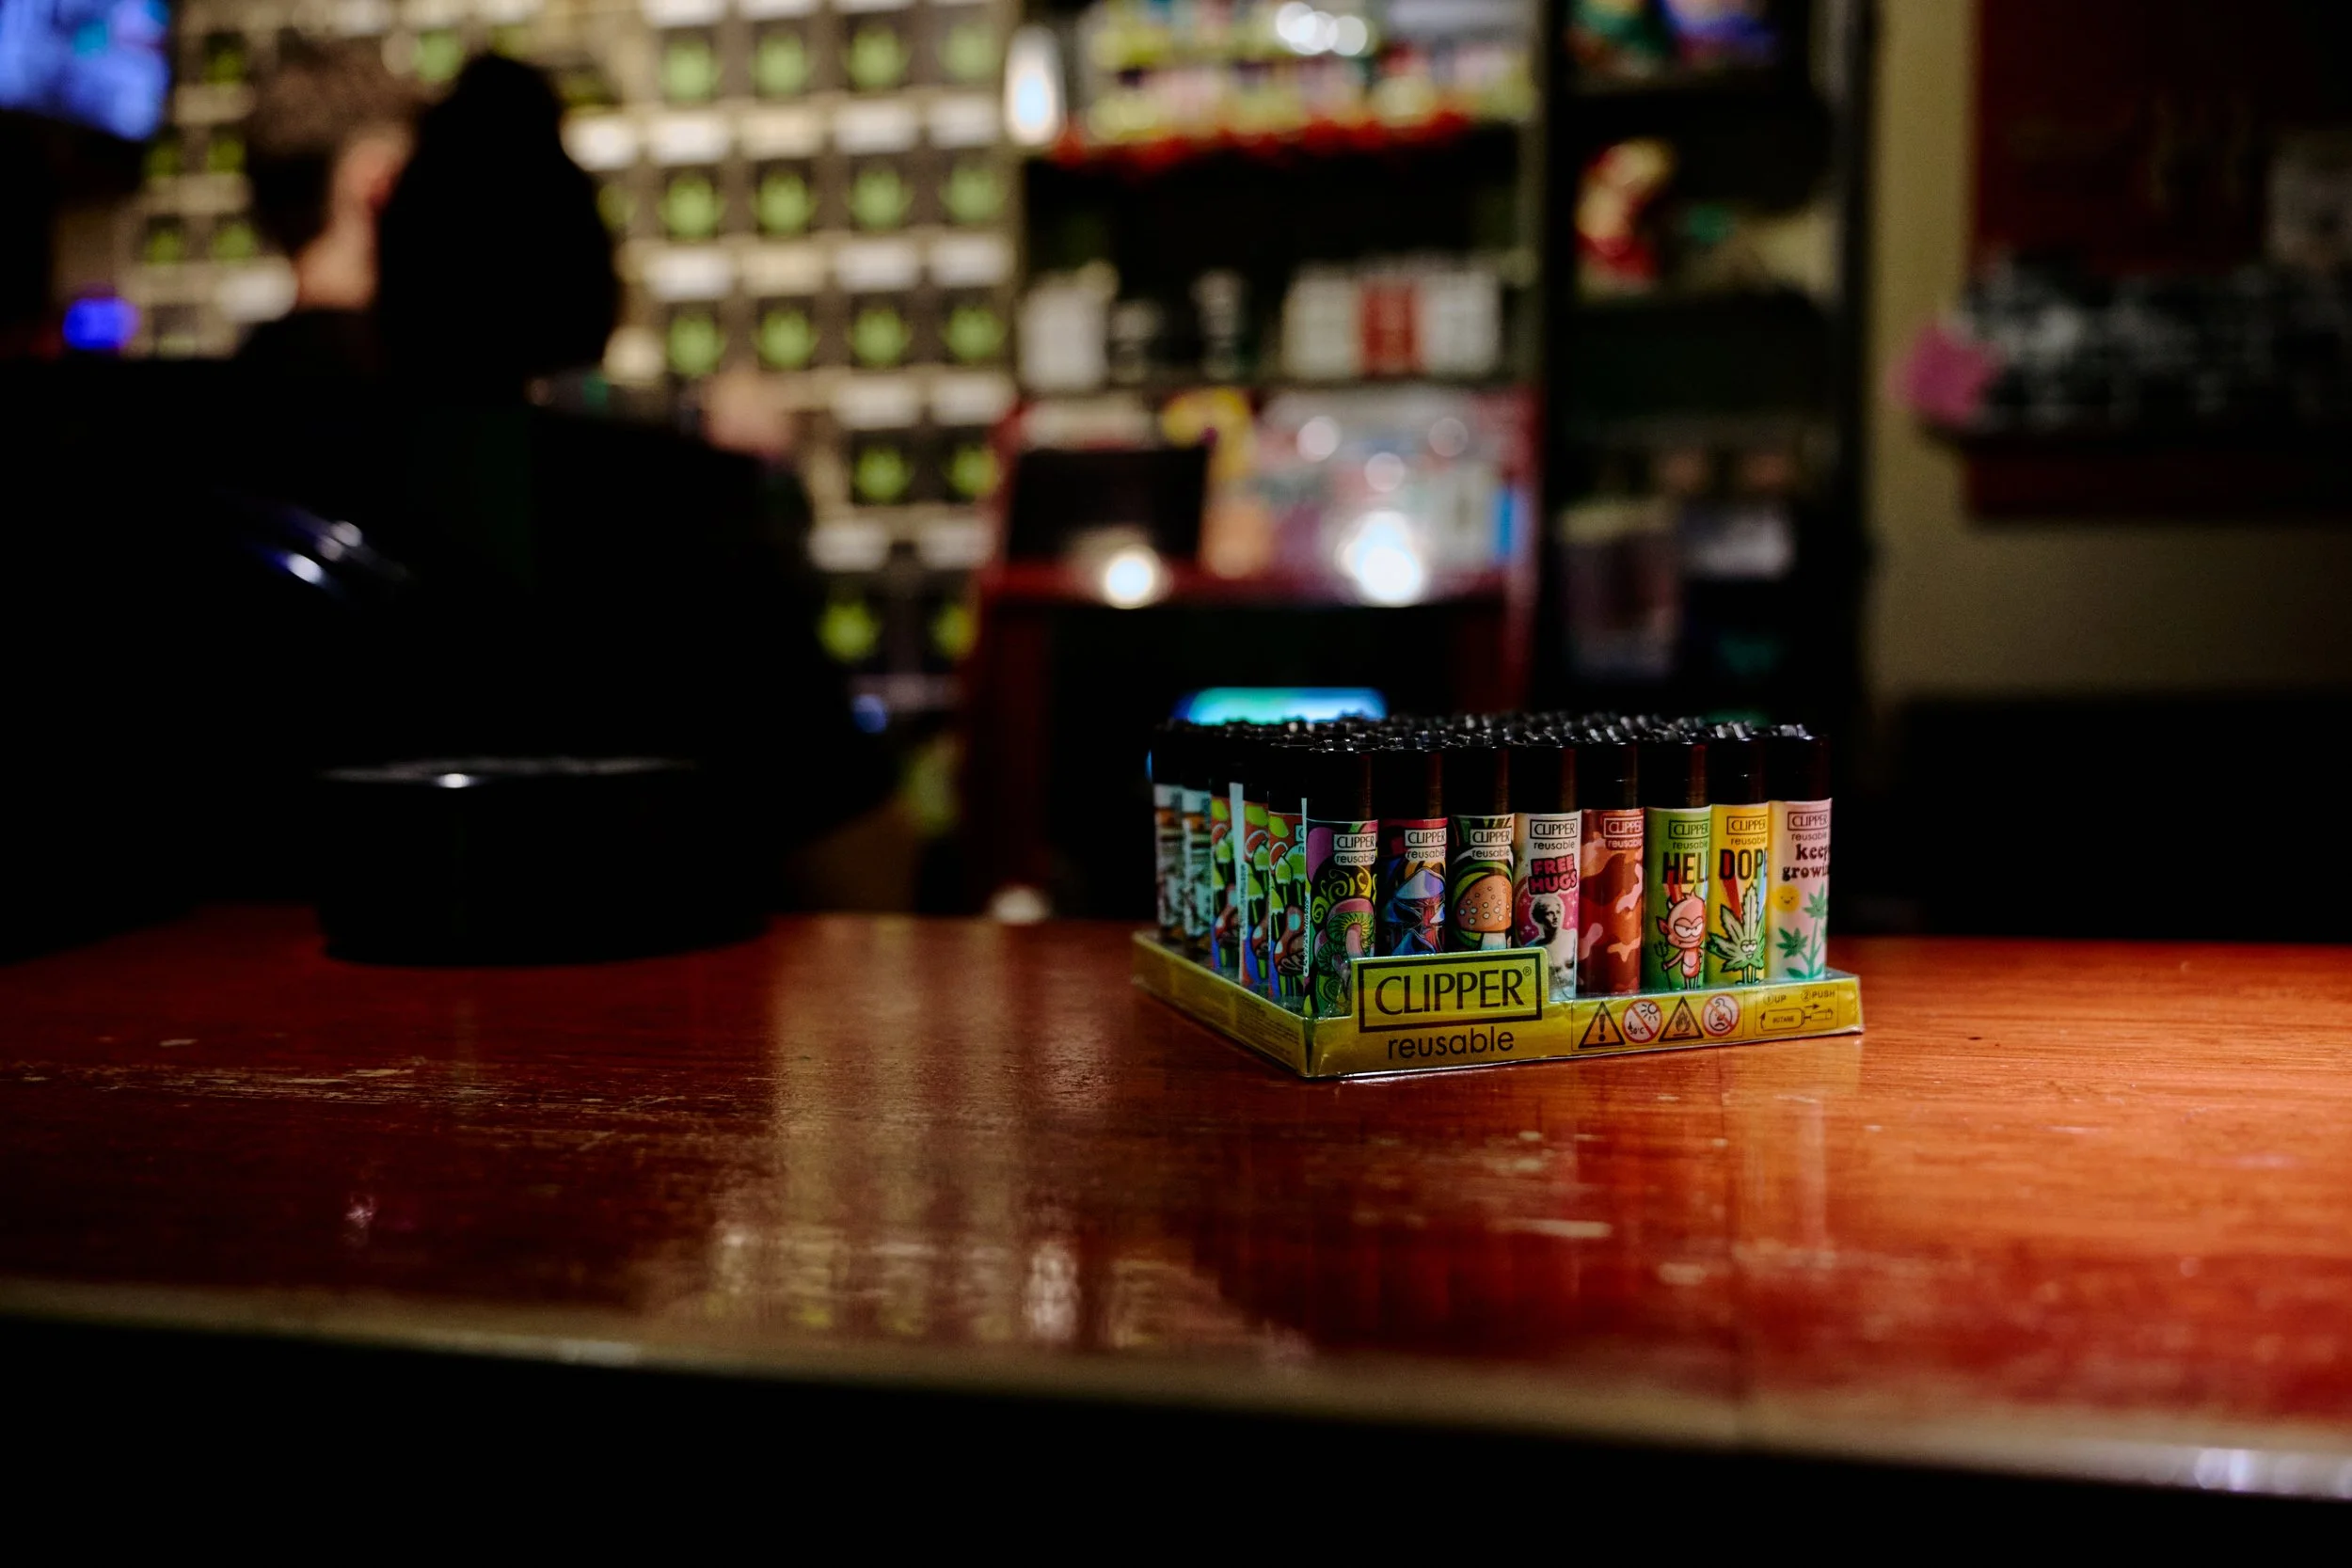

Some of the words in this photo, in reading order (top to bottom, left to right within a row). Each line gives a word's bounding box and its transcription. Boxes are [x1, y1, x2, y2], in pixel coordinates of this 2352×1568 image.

[1534, 822, 1575, 836] CLIPPER
[1336, 834, 1375, 848] CLIPPER
[1407, 830, 1445, 845] CLIPPER
[1471, 830, 1510, 844] CLIPPER
[1534, 840, 1575, 850] reusable
[1336, 852, 1375, 863] reusable
[1406, 847, 1445, 860] reusable
[1471, 847, 1510, 858] reusable
[1532, 853, 1575, 877] FREE
[1528, 869, 1577, 895] HUGS
[1774, 994, 1787, 1004] UP
[1811, 990, 1836, 1000] PUSH
[1389, 1026, 1514, 1059] reusable
